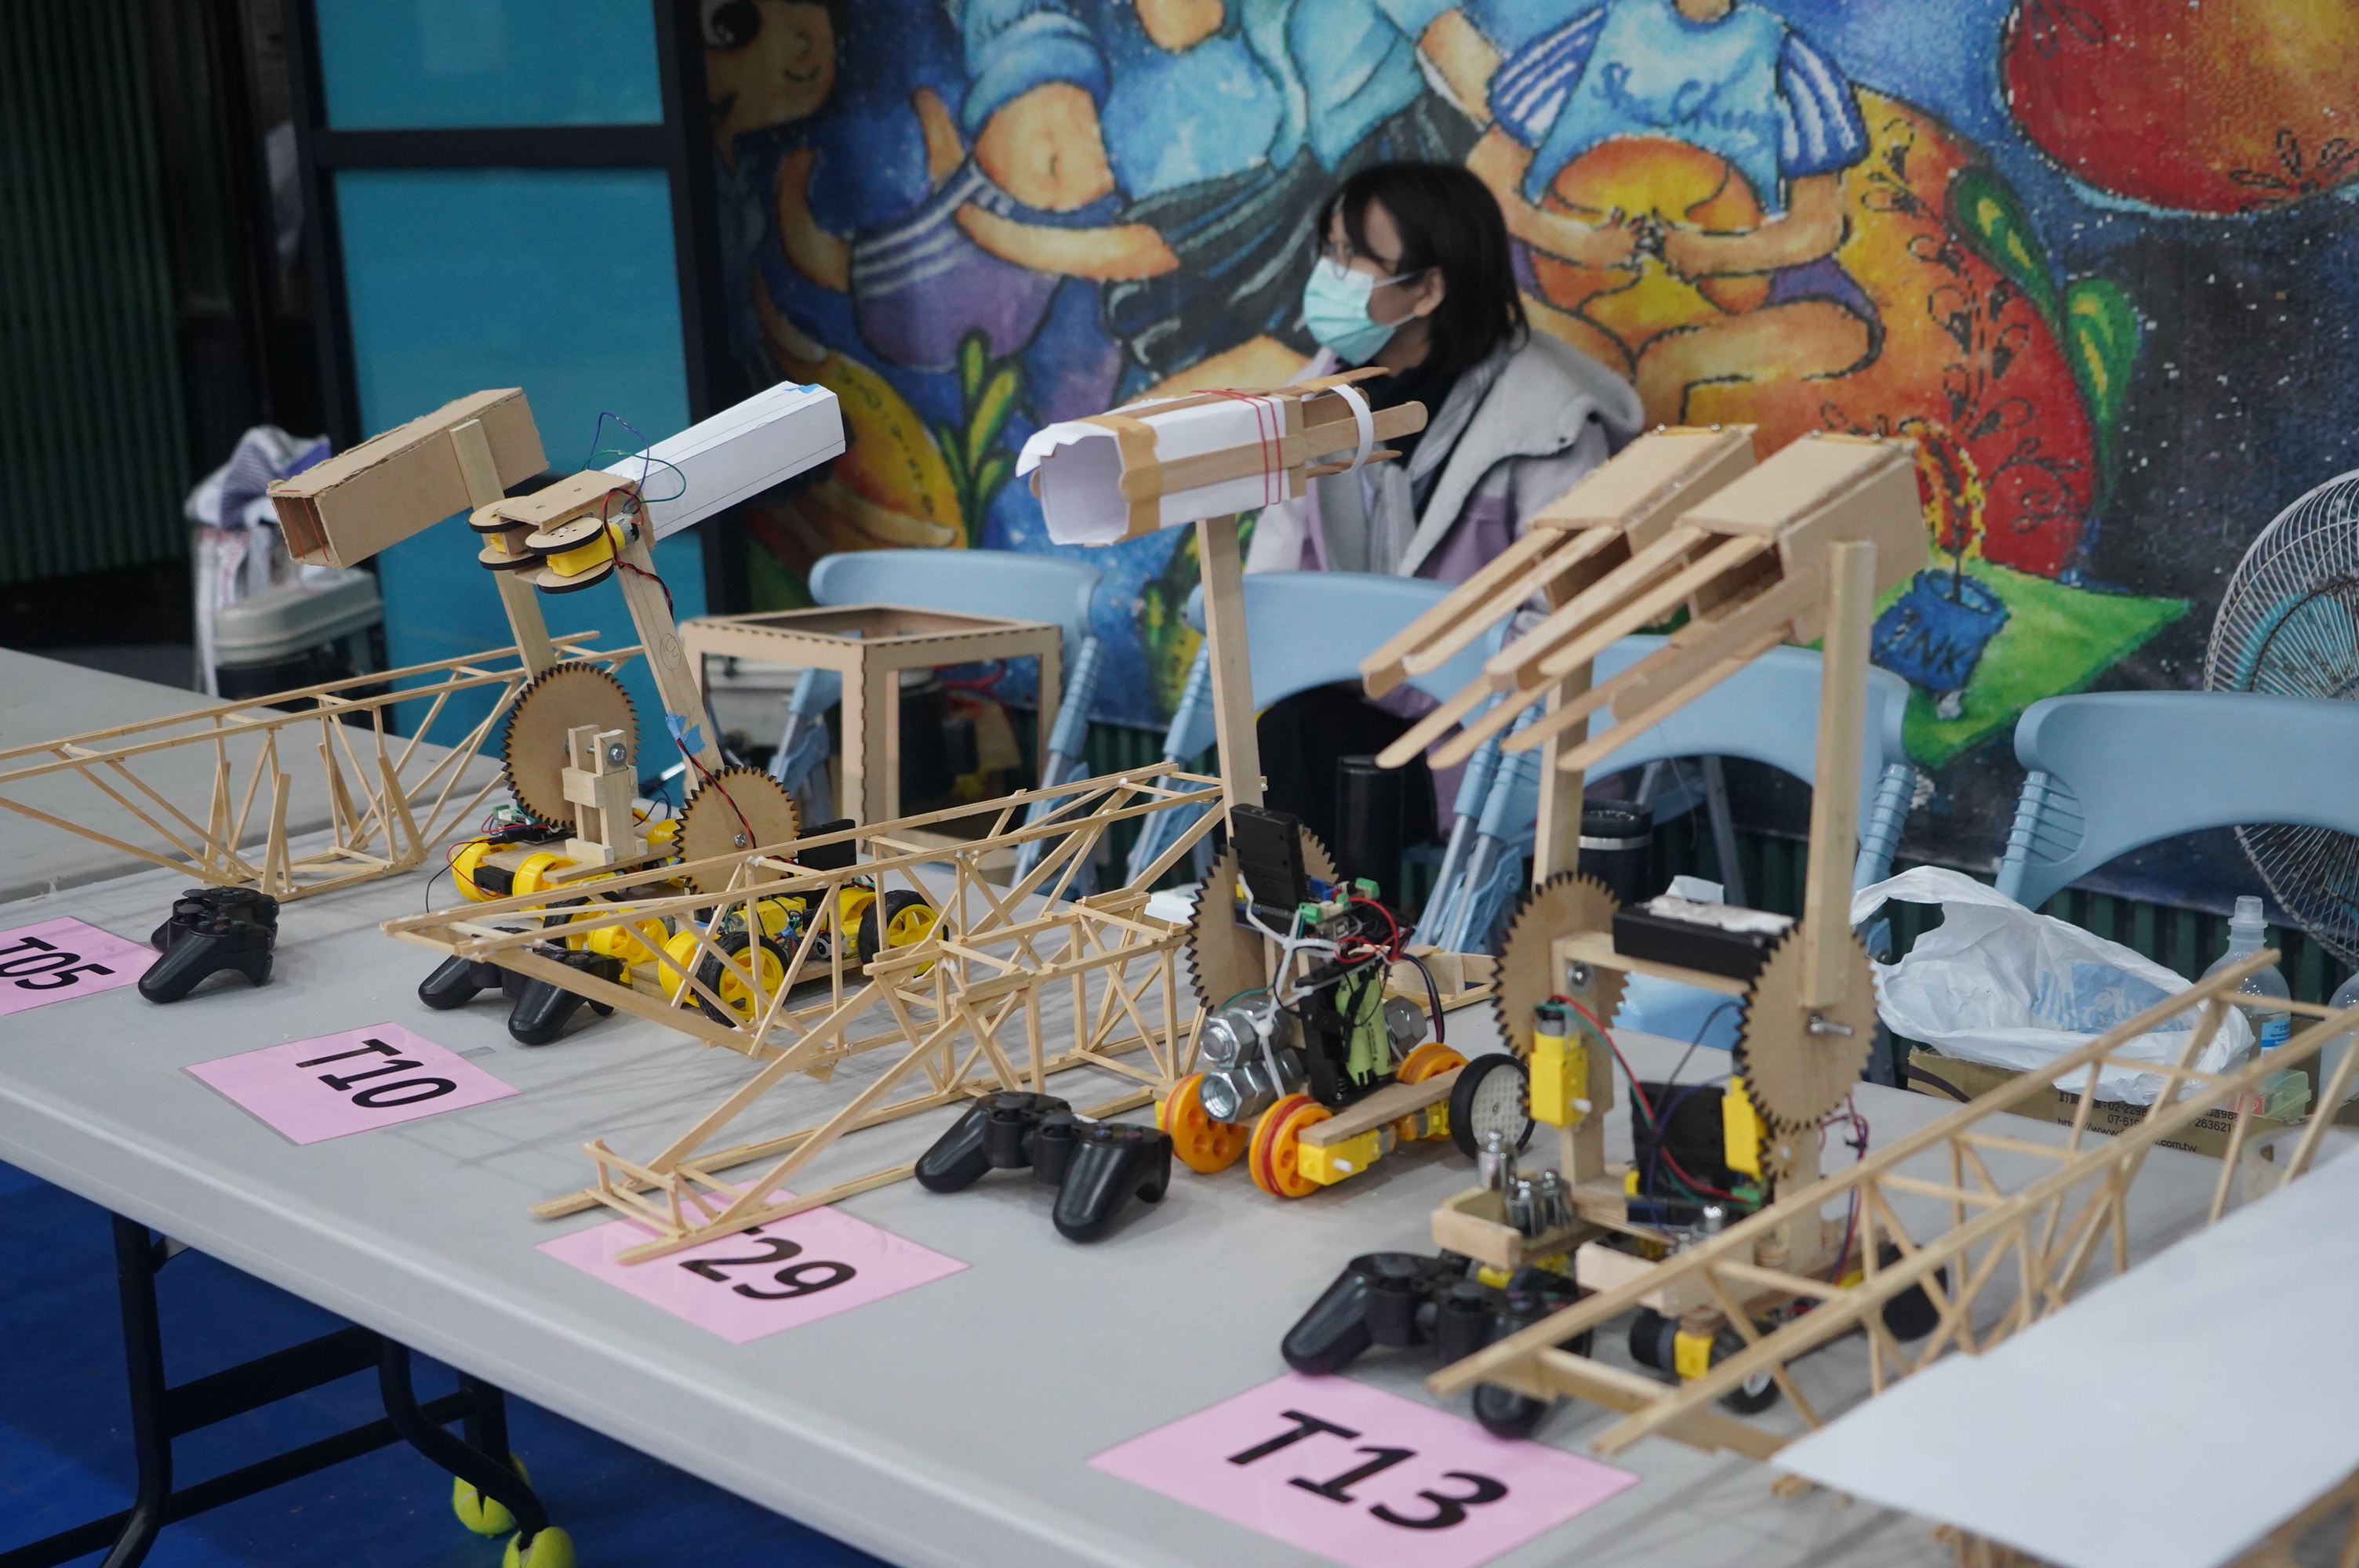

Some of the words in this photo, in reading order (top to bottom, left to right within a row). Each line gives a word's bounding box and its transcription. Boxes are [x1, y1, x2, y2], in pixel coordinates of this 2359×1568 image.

[0, 936, 116, 990] T05
[295, 1038, 457, 1109] T10
[678, 1226, 857, 1301] 29
[1226, 1409, 1509, 1530] T13
